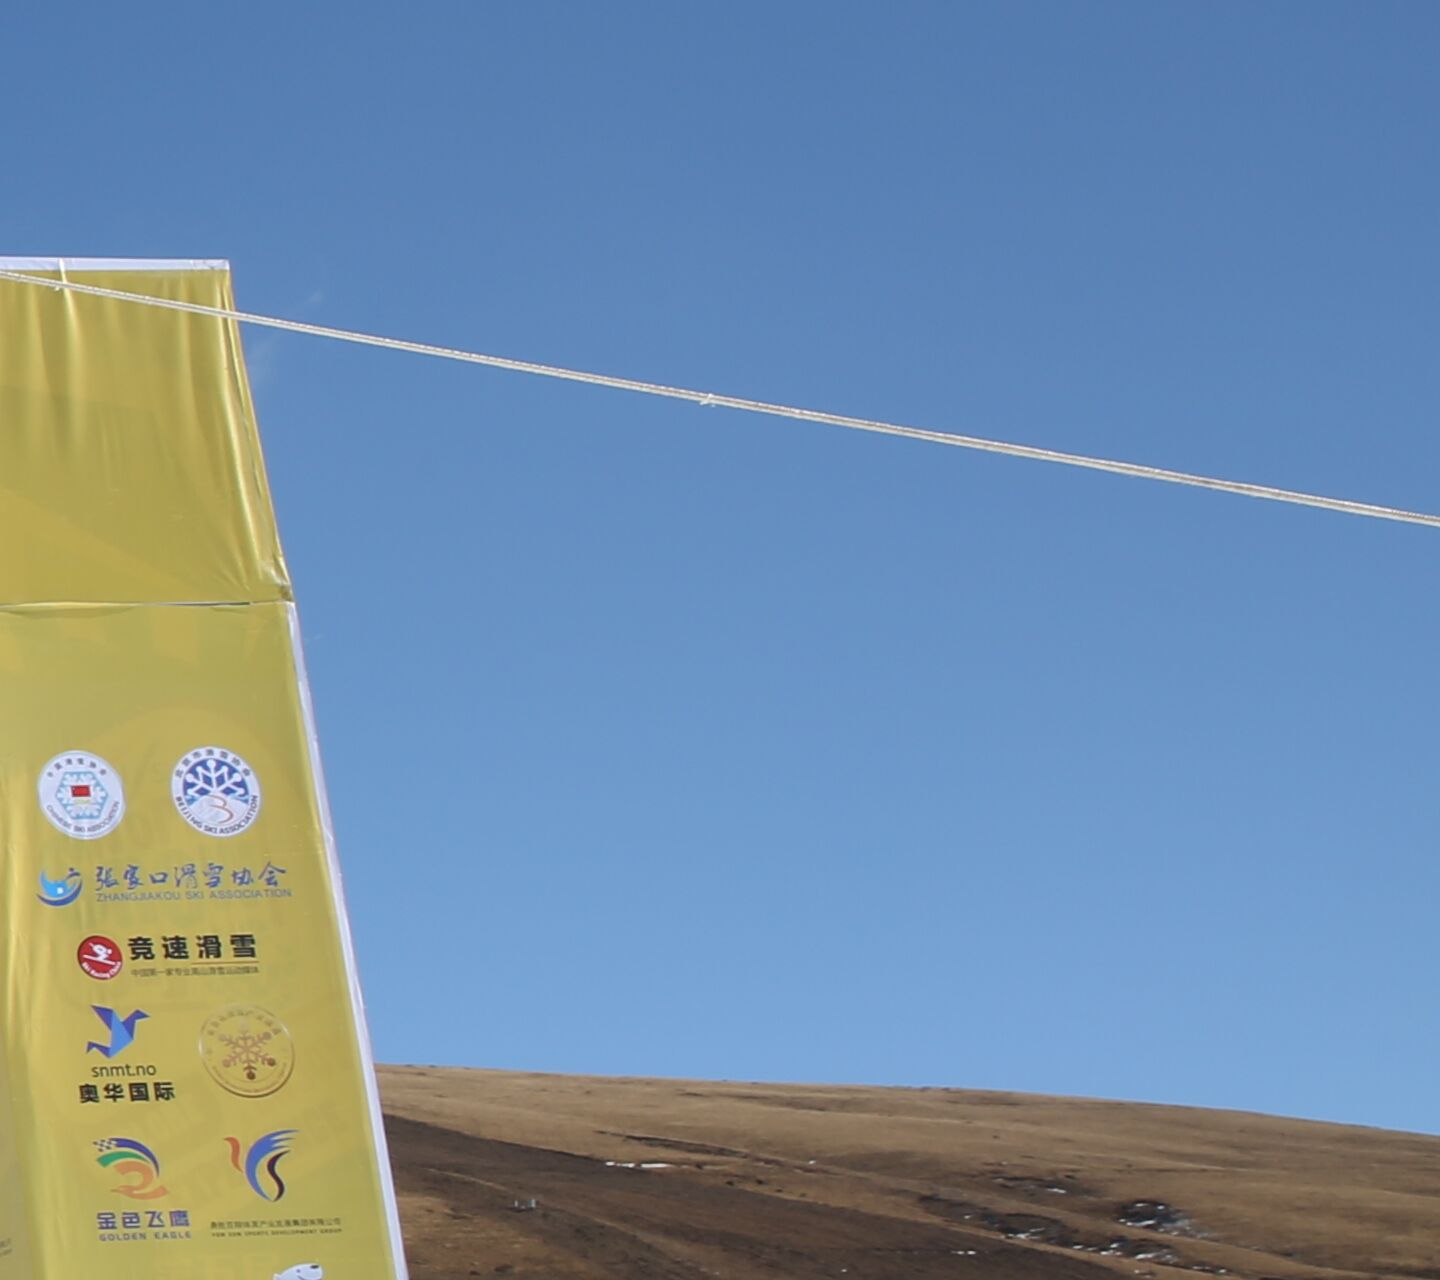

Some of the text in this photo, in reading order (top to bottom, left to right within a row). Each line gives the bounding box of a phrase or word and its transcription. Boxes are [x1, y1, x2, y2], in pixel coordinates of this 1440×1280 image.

[95, 861, 287, 892] 张家口滑雪协会
[95, 888, 293, 903] ZHANGJIAKOU SKI ASSOCIATION
[127, 934, 257, 961] 竞速滑雪
[91, 1063, 157, 1078] snmt.no
[79, 1081, 176, 1104] 奥华国际
[96, 1209, 191, 1230] 金色飞鹰
[98, 1230, 192, 1242] GOLDEN EAGLE
